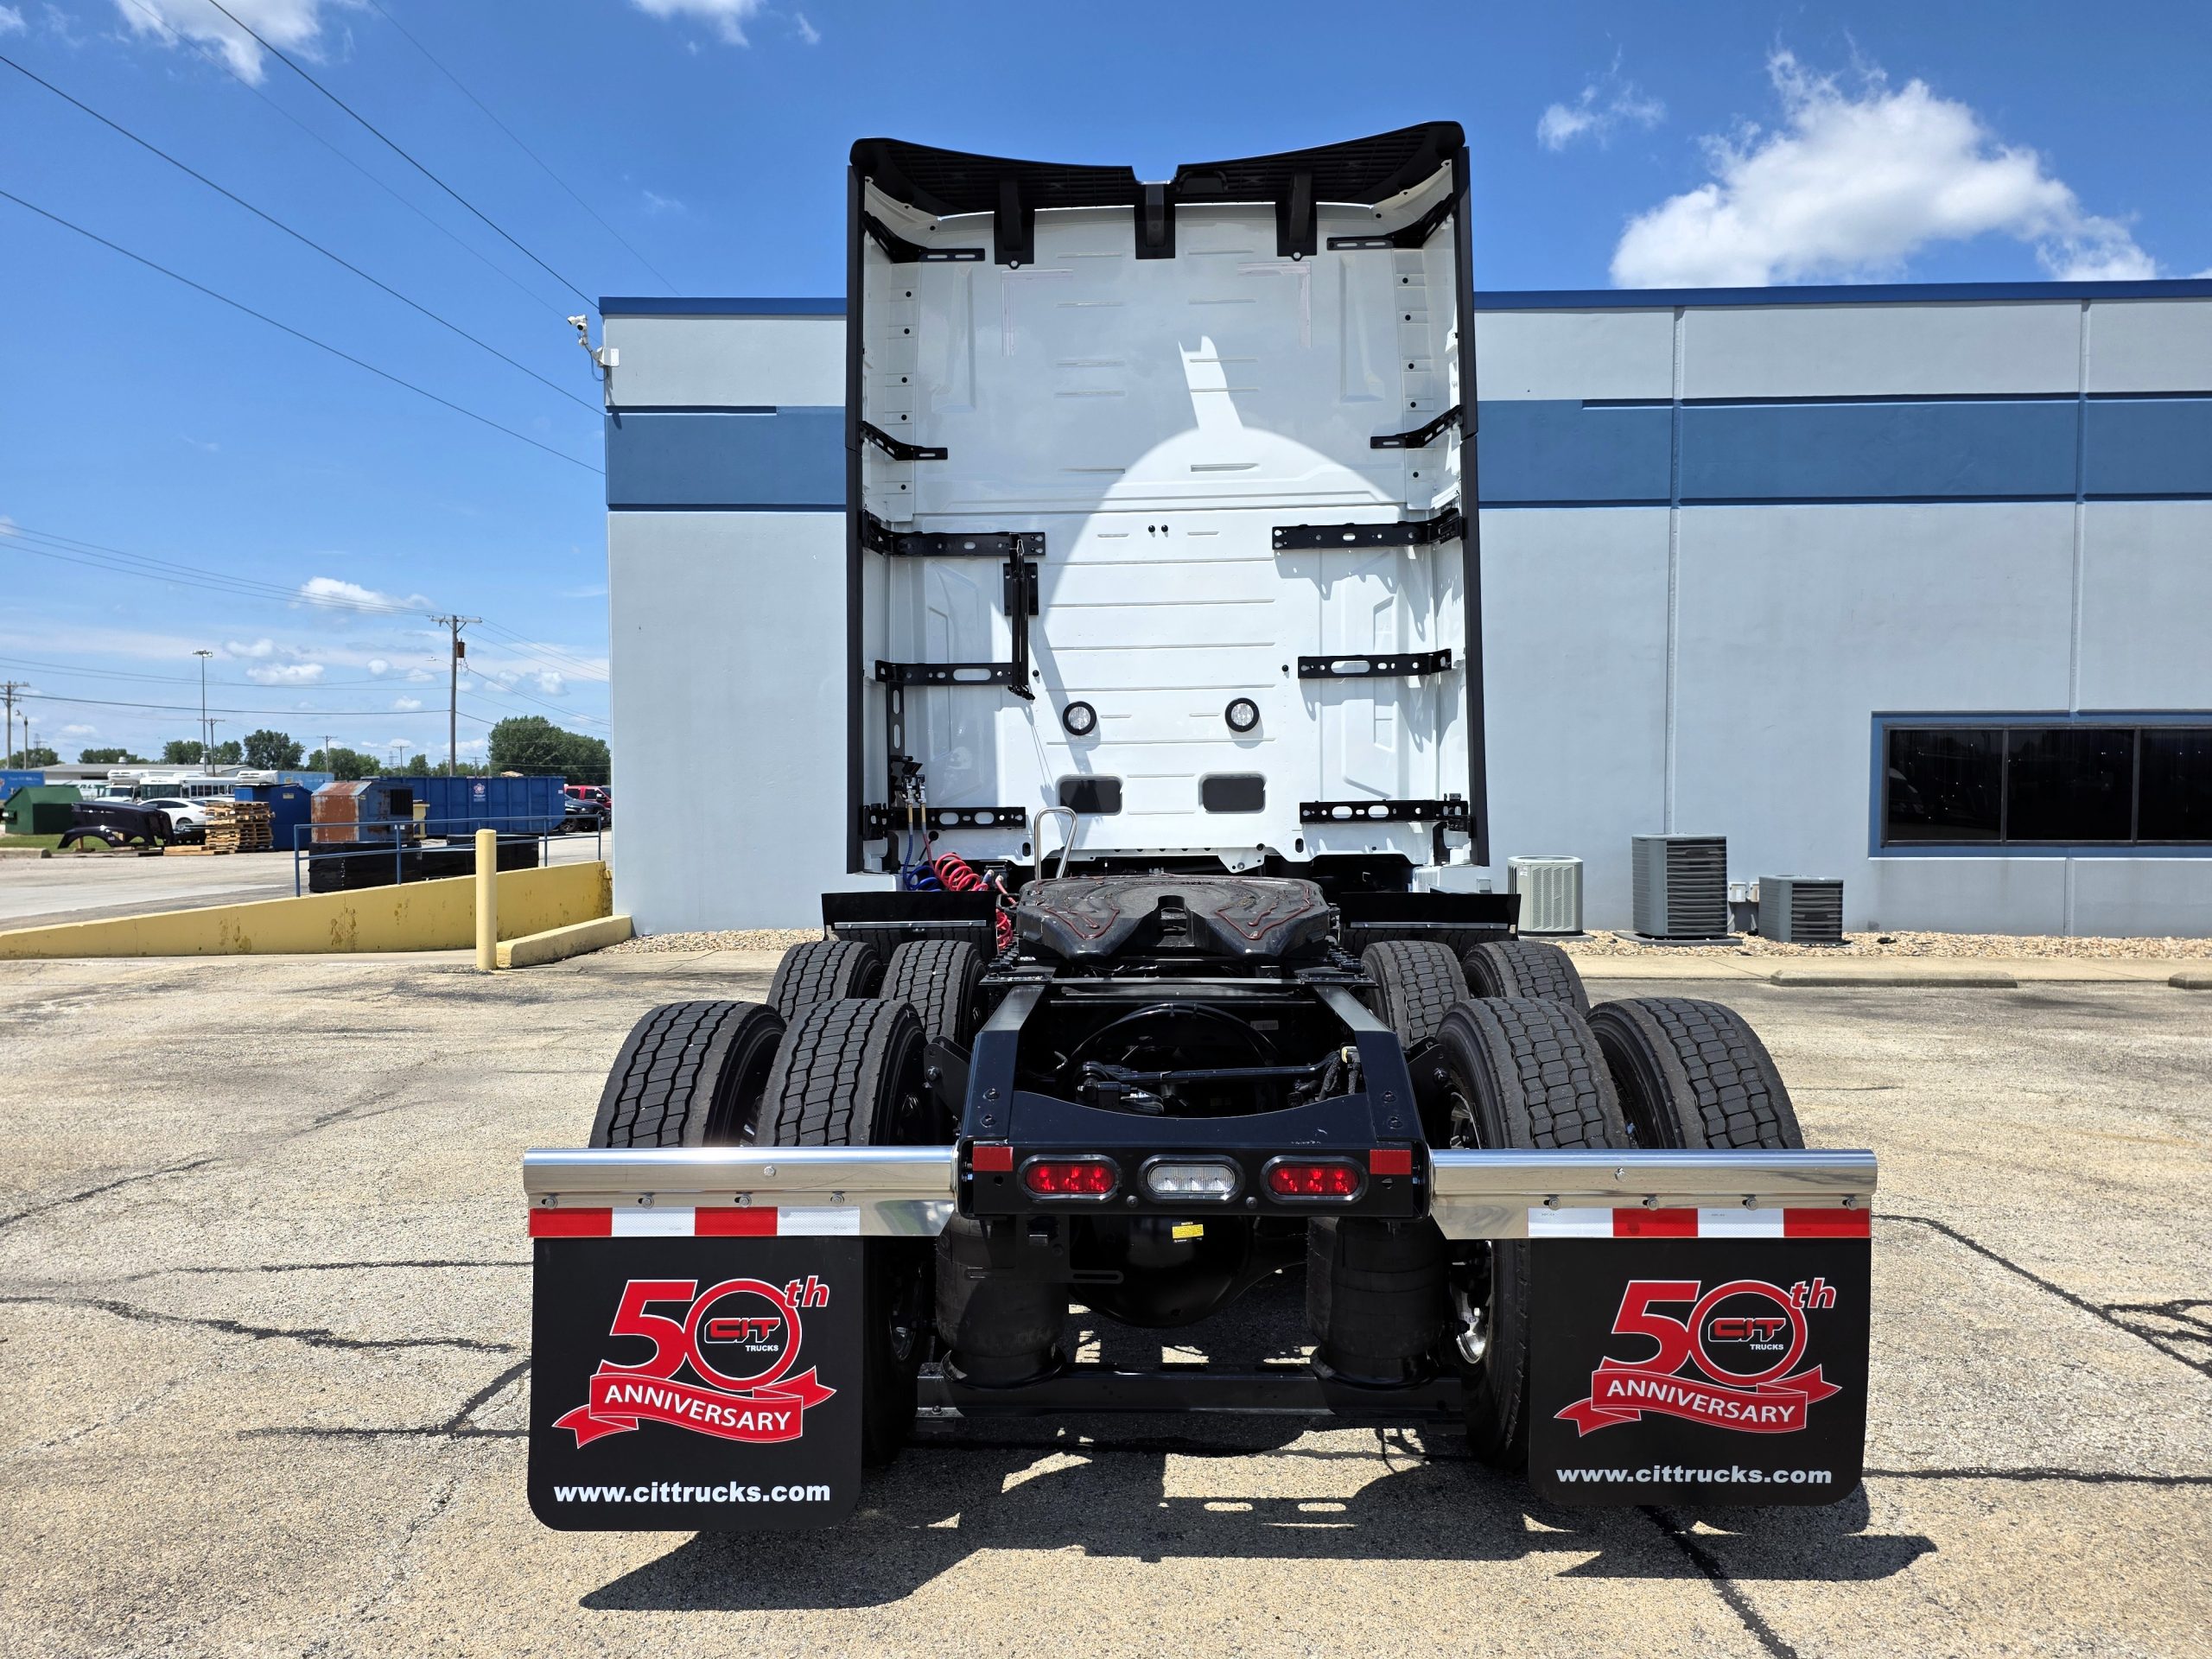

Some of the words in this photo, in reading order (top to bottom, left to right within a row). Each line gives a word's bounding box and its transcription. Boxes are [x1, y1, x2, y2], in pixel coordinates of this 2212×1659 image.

[704, 1317, 781, 1344] CIT
[1708, 1317, 1786, 1343] CIT
[604, 1384, 791, 1431] ANNIVERSARY
[1606, 1379, 1796, 1423] ANNIVERSARY
[1556, 1465, 1832, 1484] www.cittrucks.com
[554, 1481, 830, 1503] www.cittrucks.com
